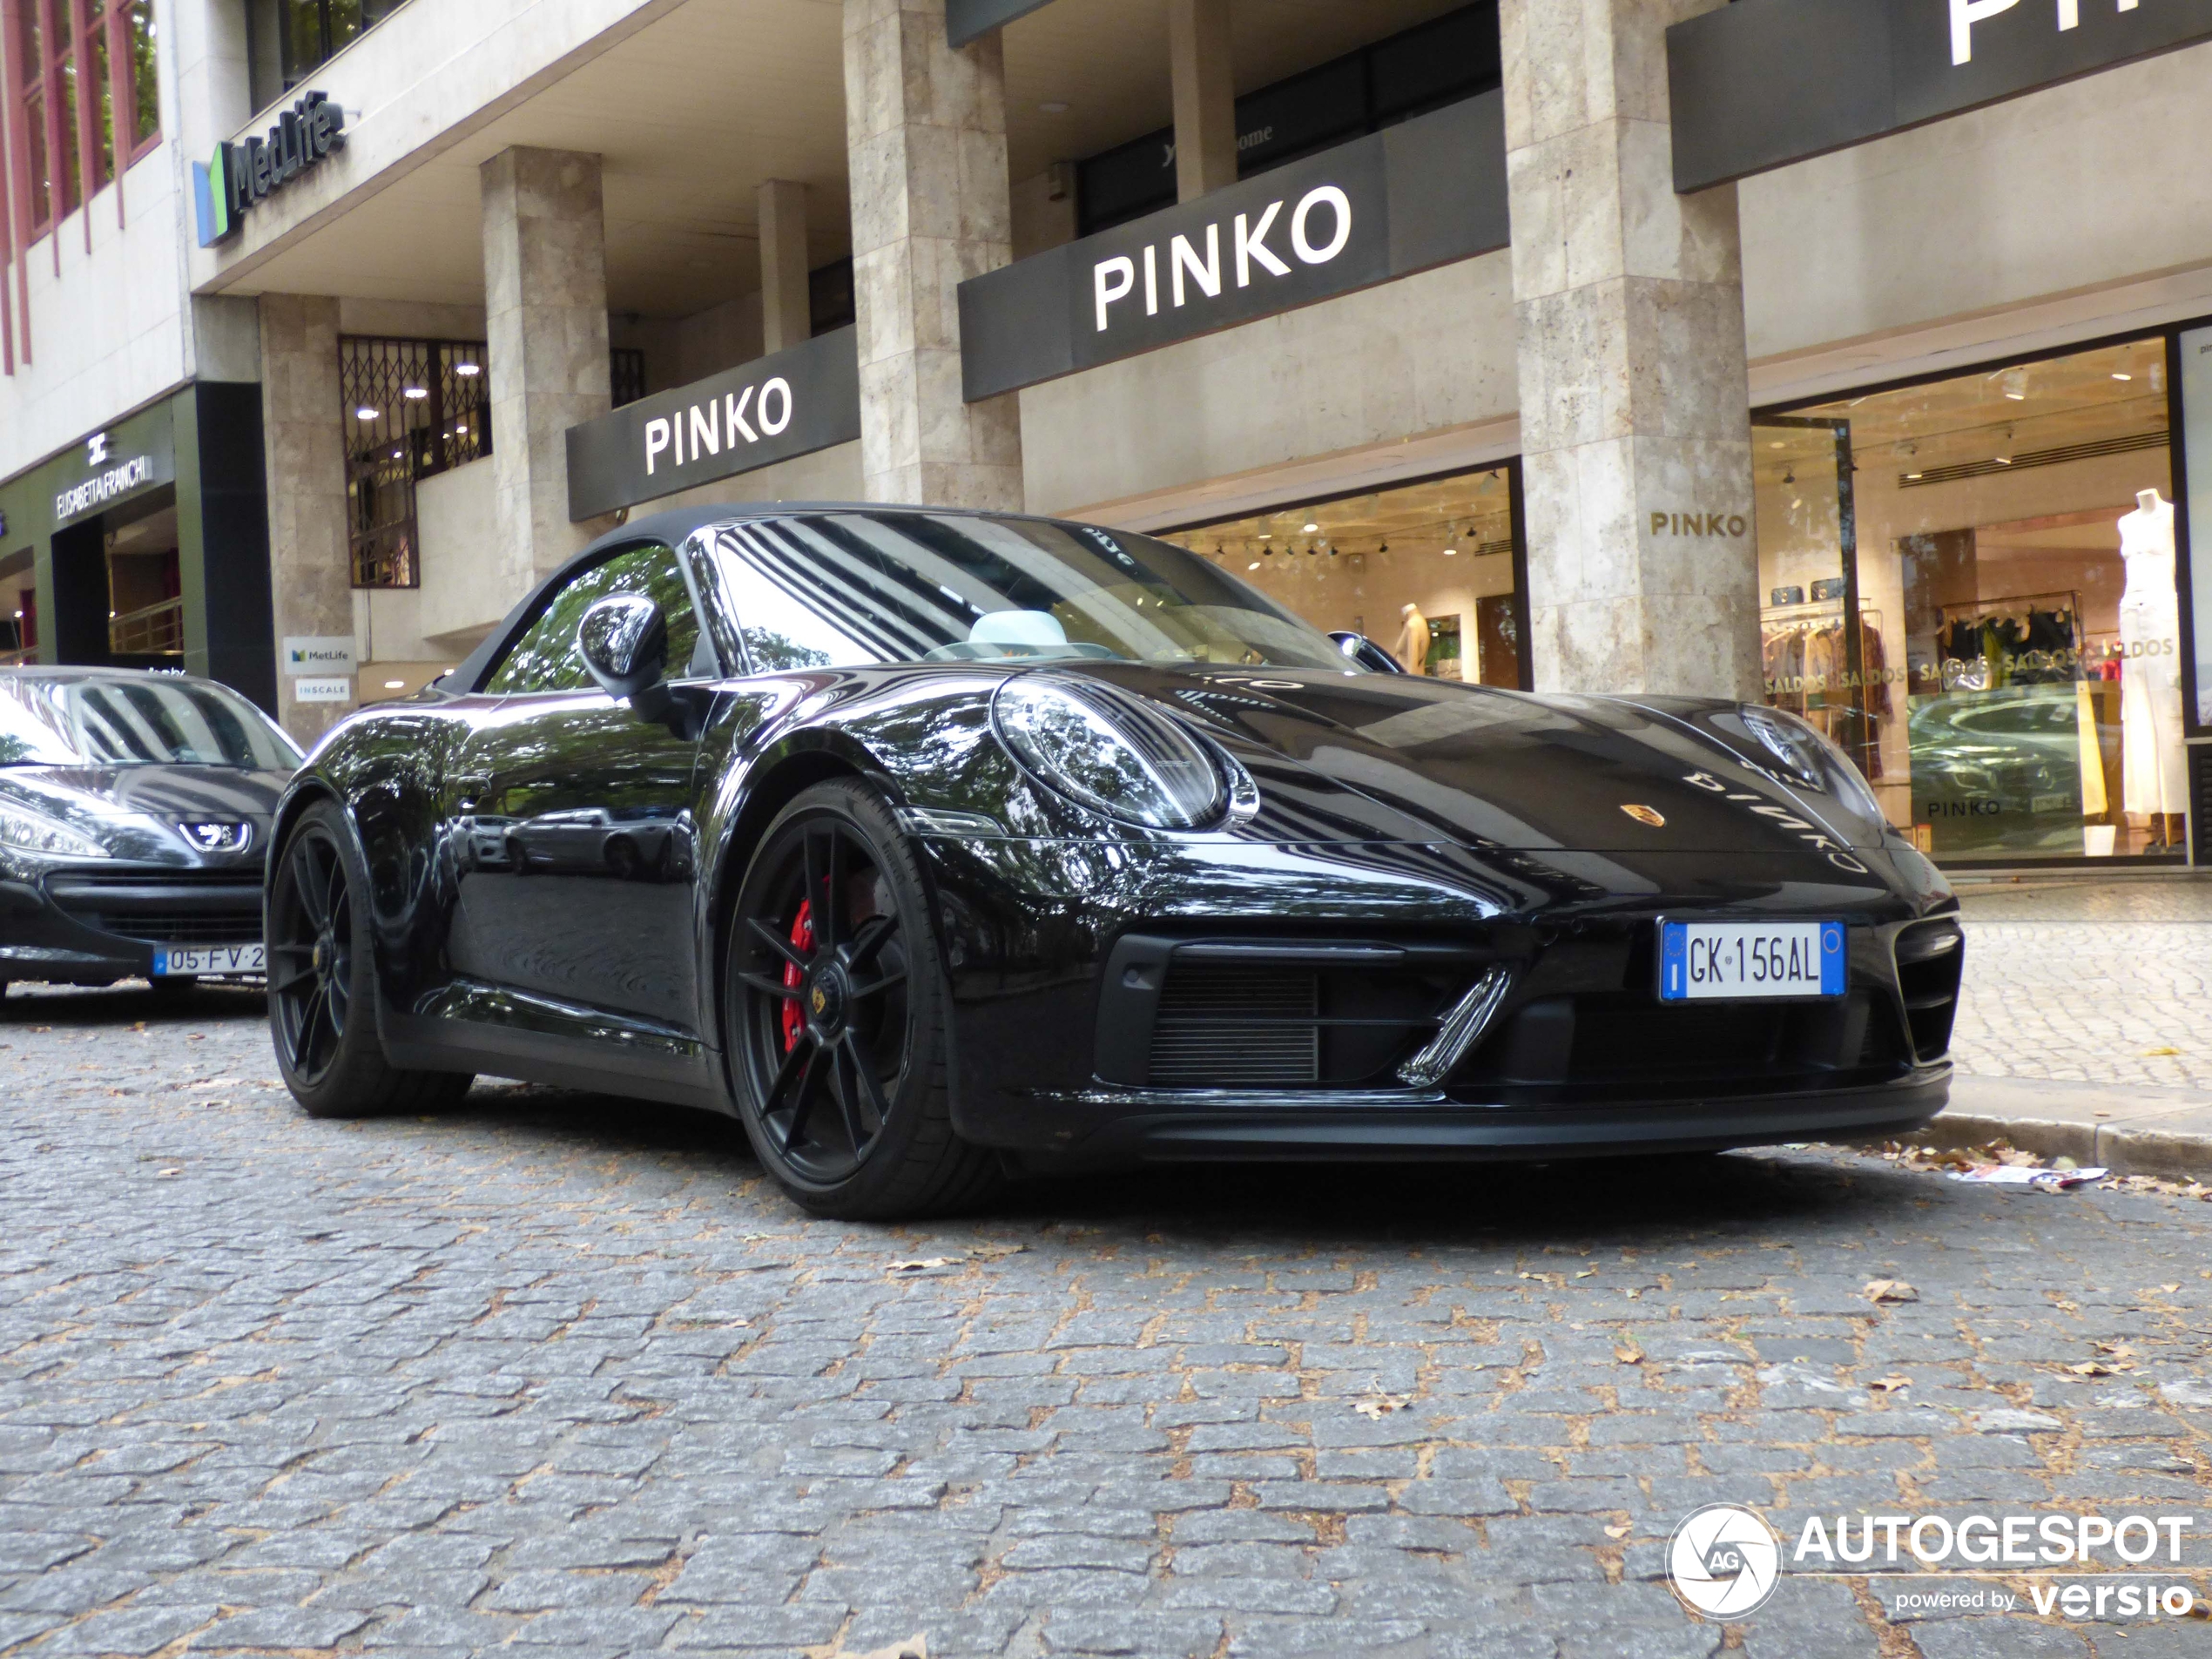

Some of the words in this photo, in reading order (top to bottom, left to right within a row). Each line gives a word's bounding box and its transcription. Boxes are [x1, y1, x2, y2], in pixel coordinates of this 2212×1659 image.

[231, 90, 338, 208] MetLife
[1095, 185, 1352, 333] PINKO
[644, 376, 792, 475] PINKO
[57, 475, 104, 521] ELISABETTA
[104, 455, 146, 501] FRANCHI
[1650, 512, 1747, 537] PINKO
[308, 650, 348, 660] MetLife
[1764, 674, 1826, 695] SALDOS
[1840, 667, 1905, 688] SALDOS
[1920, 654, 1988, 682] SAOS
[2004, 647, 2078, 673] SALDOS
[300, 685, 345, 694] INSCALE
[1928, 792, 2000, 817] PINKO
